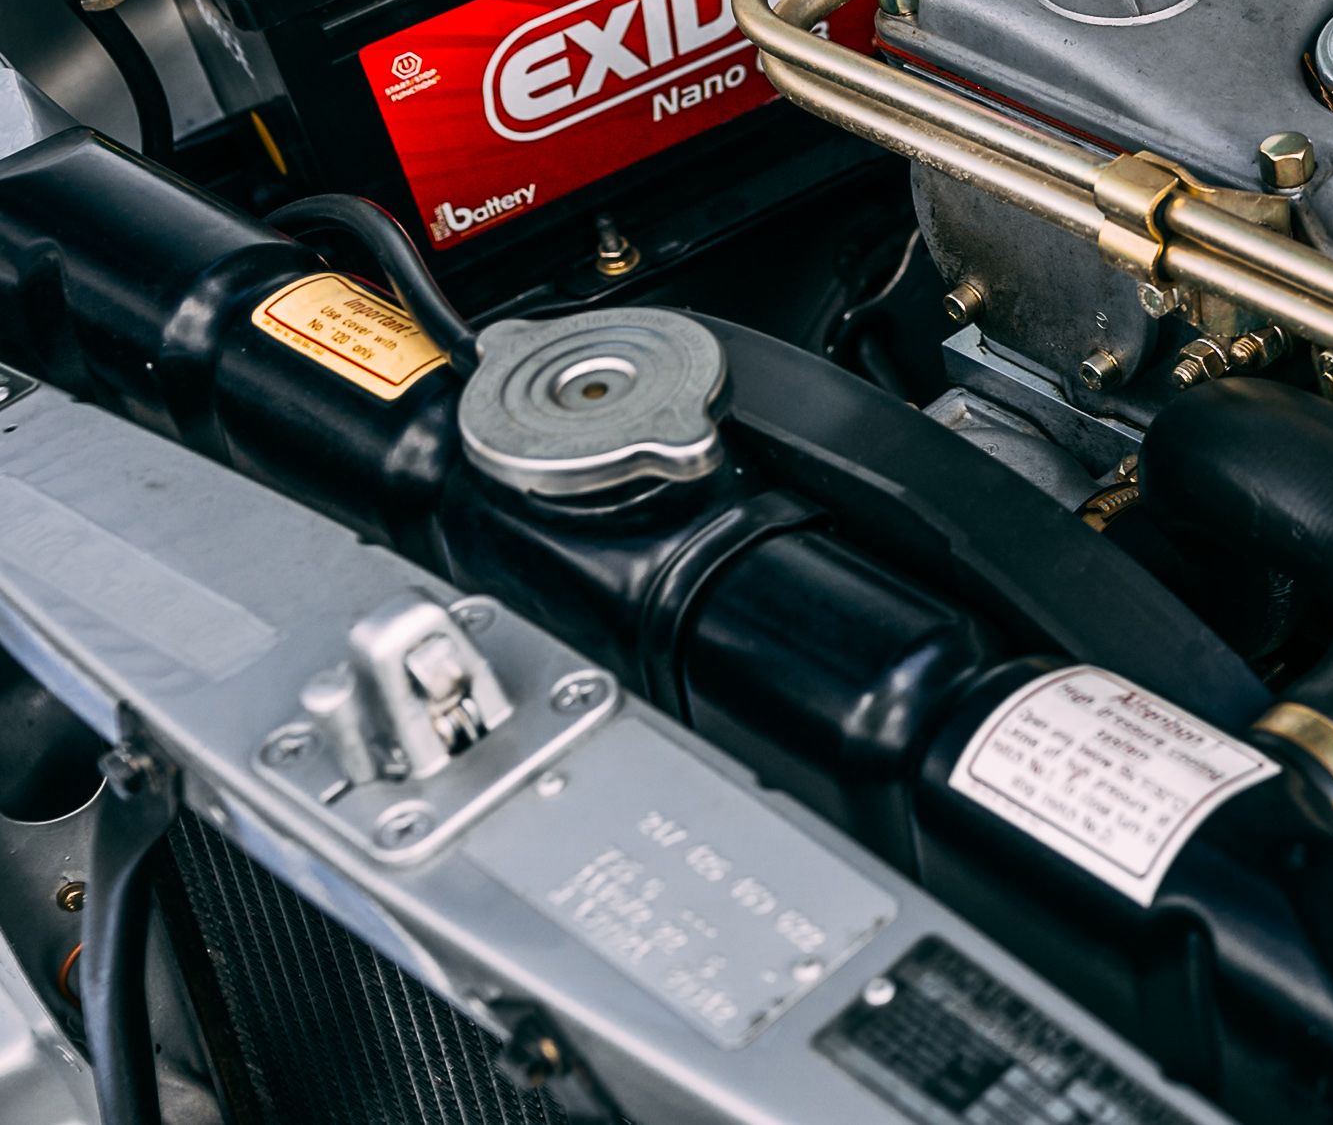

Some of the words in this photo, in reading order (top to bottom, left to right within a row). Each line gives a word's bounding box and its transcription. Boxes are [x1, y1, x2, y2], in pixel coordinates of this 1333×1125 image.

[653, 64, 747, 122] Nano
[441, 183, 536, 232] battery
[320, 305, 342, 321] Use
[343, 318, 372, 336] cover
[373, 333, 399, 351] with
[344, 298, 410, 335] Important
[352, 342, 377, 361] only
